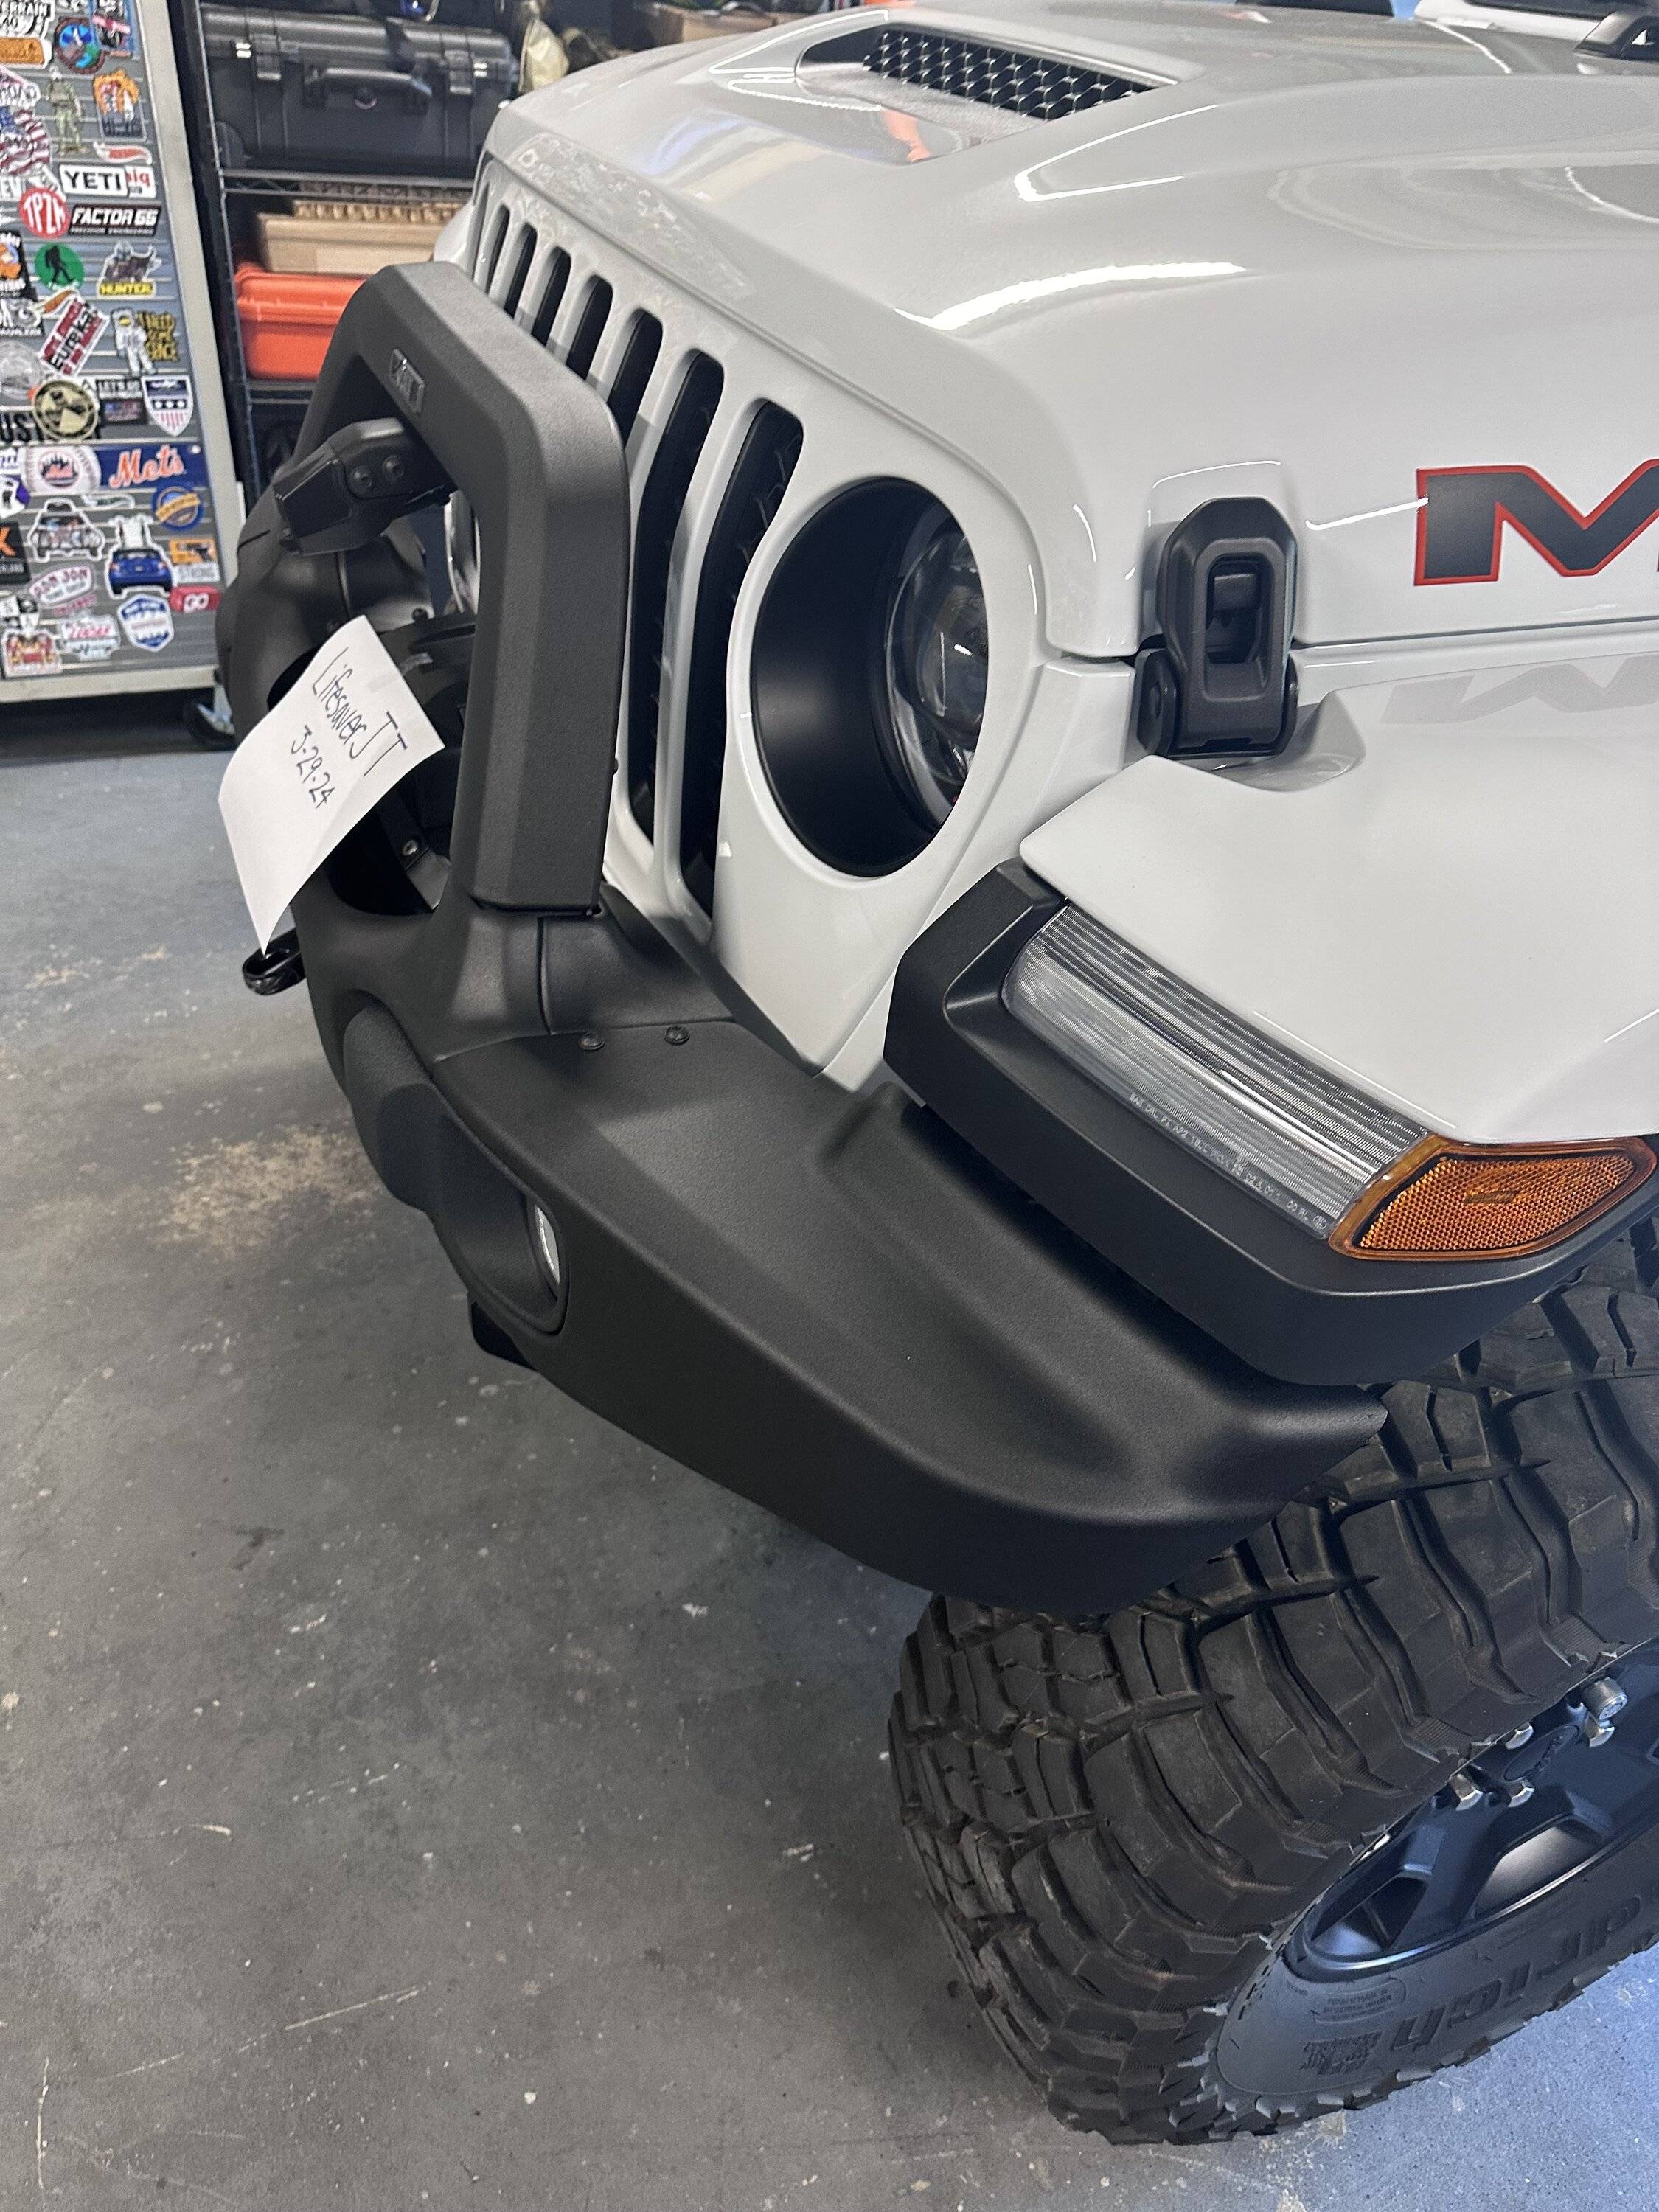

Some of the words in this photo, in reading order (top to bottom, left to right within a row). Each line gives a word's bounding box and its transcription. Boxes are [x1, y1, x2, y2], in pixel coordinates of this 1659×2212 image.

[64, 168, 122, 190] YETI
[72, 207, 134, 226] FACTOR
[108, 444, 185, 488] Mets
